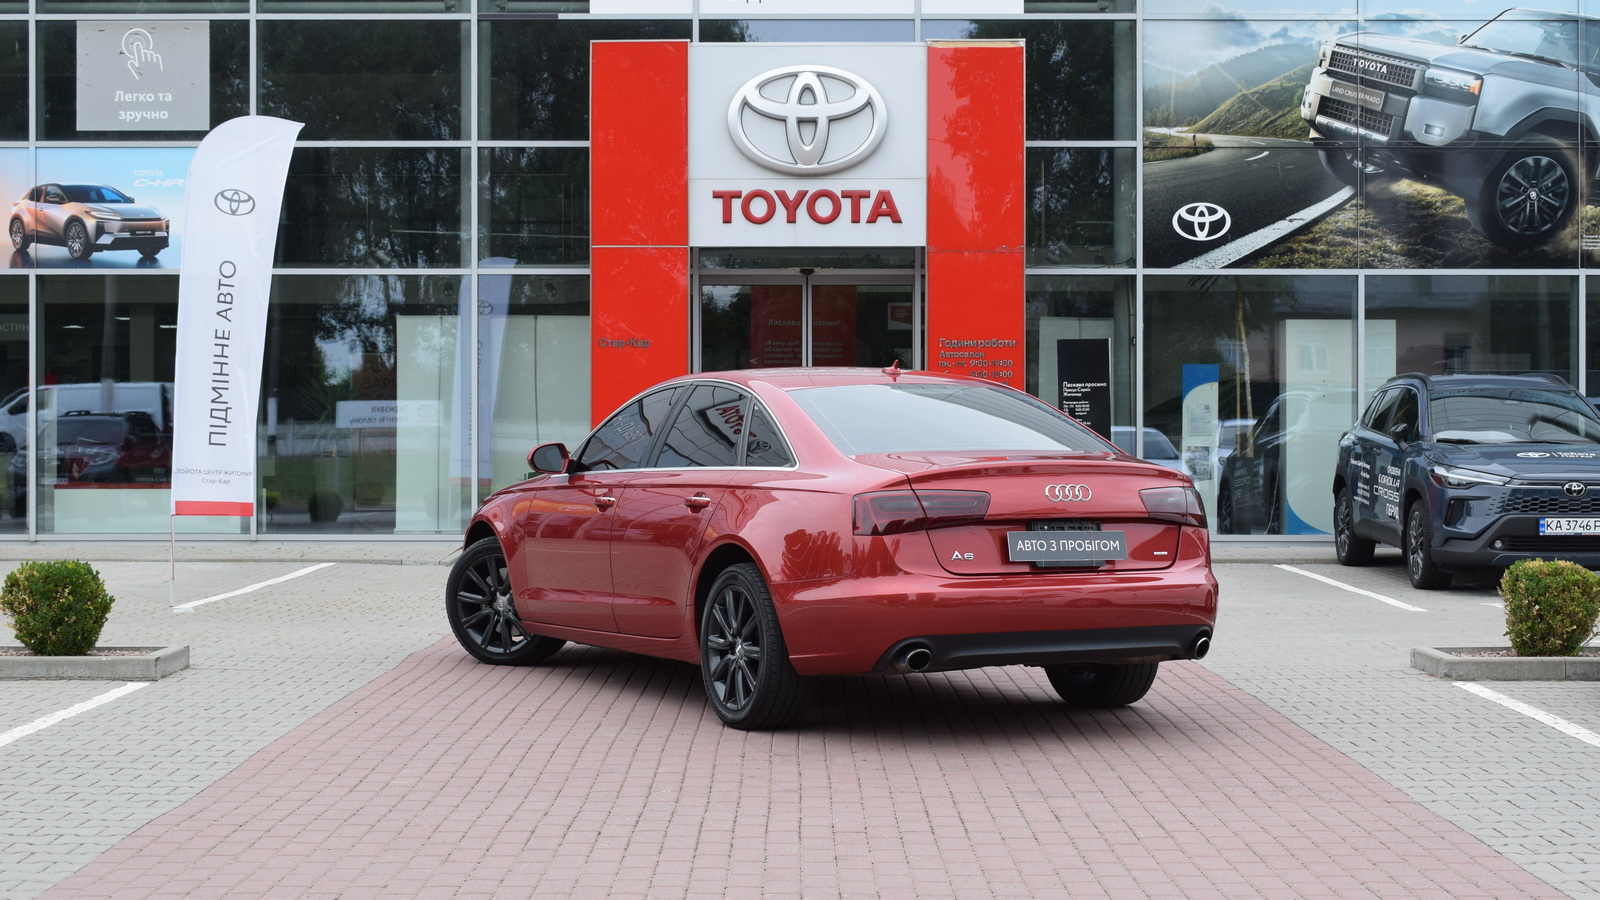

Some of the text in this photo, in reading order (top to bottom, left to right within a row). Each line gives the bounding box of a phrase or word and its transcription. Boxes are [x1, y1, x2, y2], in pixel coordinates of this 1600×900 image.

[1353, 58, 1387, 74] TOYOTA
[114, 90, 173, 102] Легко та
[1332, 86, 1380, 104] LAND CRUISER PRADO
[118, 110, 169, 123] зручно
[132, 169, 165, 177] TOYOTA
[132, 178, 185, 188] C-HR
[712, 189, 903, 225] TOYOTA
[598, 337, 652, 350] Стар-Кар
[938, 337, 1017, 350] Години роботи
[208, 260, 237, 447] ПІДМІННЕ АВТО
[939, 350, 986, 359] Автосалон
[201, 477, 231, 485] Стар-Кар
[1378, 474, 1400, 488] COROLLA
[1374, 484, 1400, 502] CROSS
[1565, 520, 1592, 531] 3746
[1016, 540, 1047, 551] АВТО
[1059, 539, 1120, 551] ПРОБІГОМ
[951, 550, 974, 560] A6
